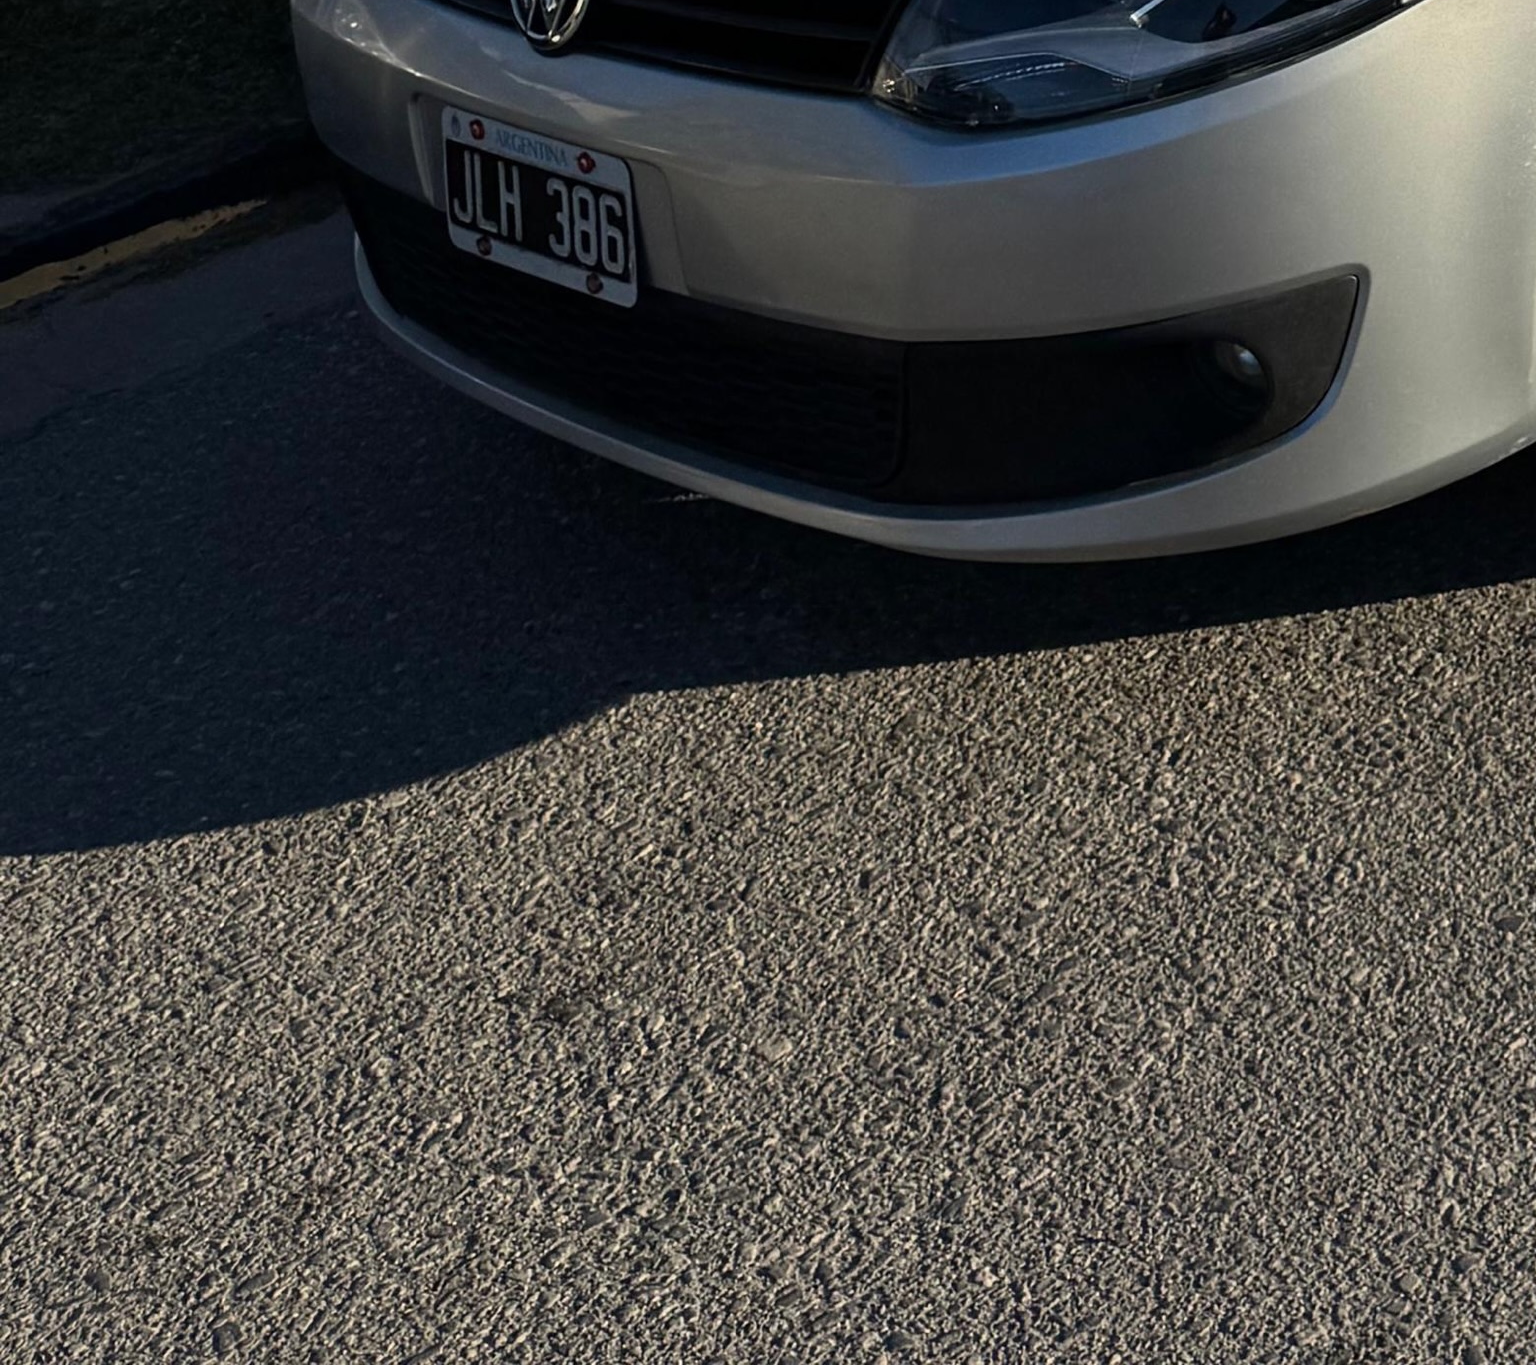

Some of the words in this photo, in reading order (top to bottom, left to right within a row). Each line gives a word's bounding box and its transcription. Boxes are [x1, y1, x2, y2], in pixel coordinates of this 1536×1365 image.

[494, 129, 568, 168] ARGENTINA
[453, 150, 523, 242] JLH
[546, 177, 626, 275] 386
